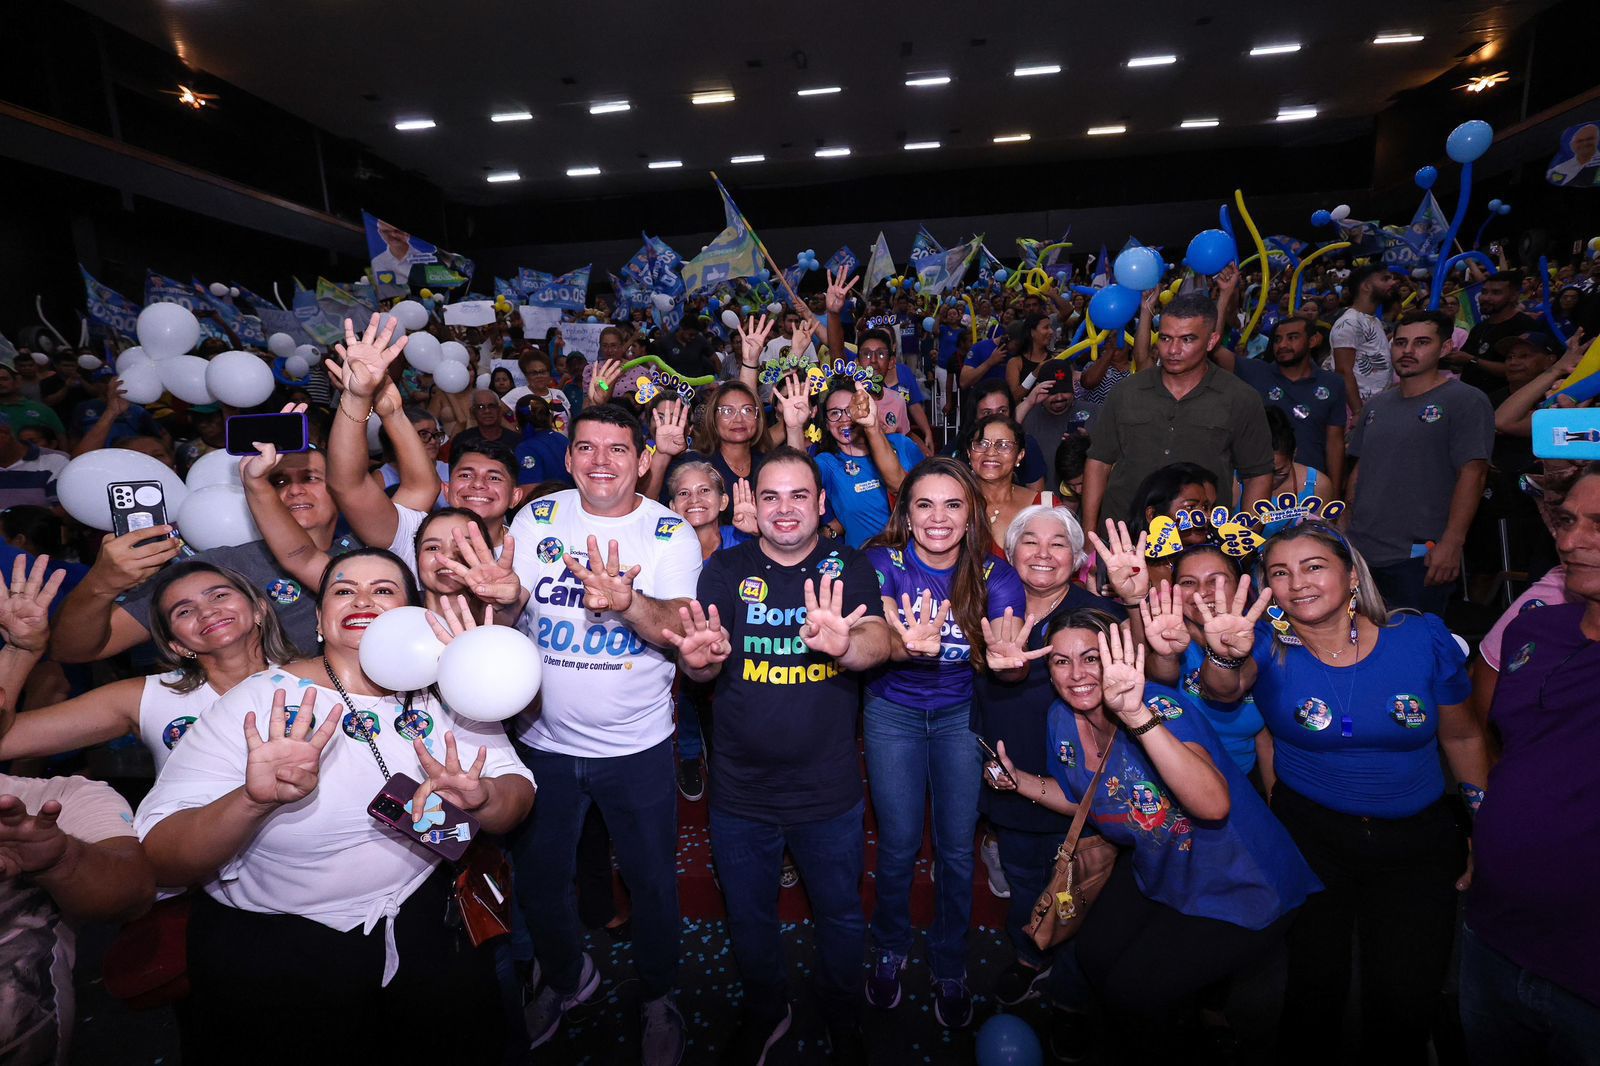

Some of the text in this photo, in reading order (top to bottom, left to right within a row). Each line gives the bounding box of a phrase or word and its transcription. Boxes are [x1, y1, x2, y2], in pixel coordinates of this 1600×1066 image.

[548, 656, 561, 667] bem
[561, 658, 575, 668] tem
[576, 661, 590, 670] que
[589, 662, 623, 671] continuar
